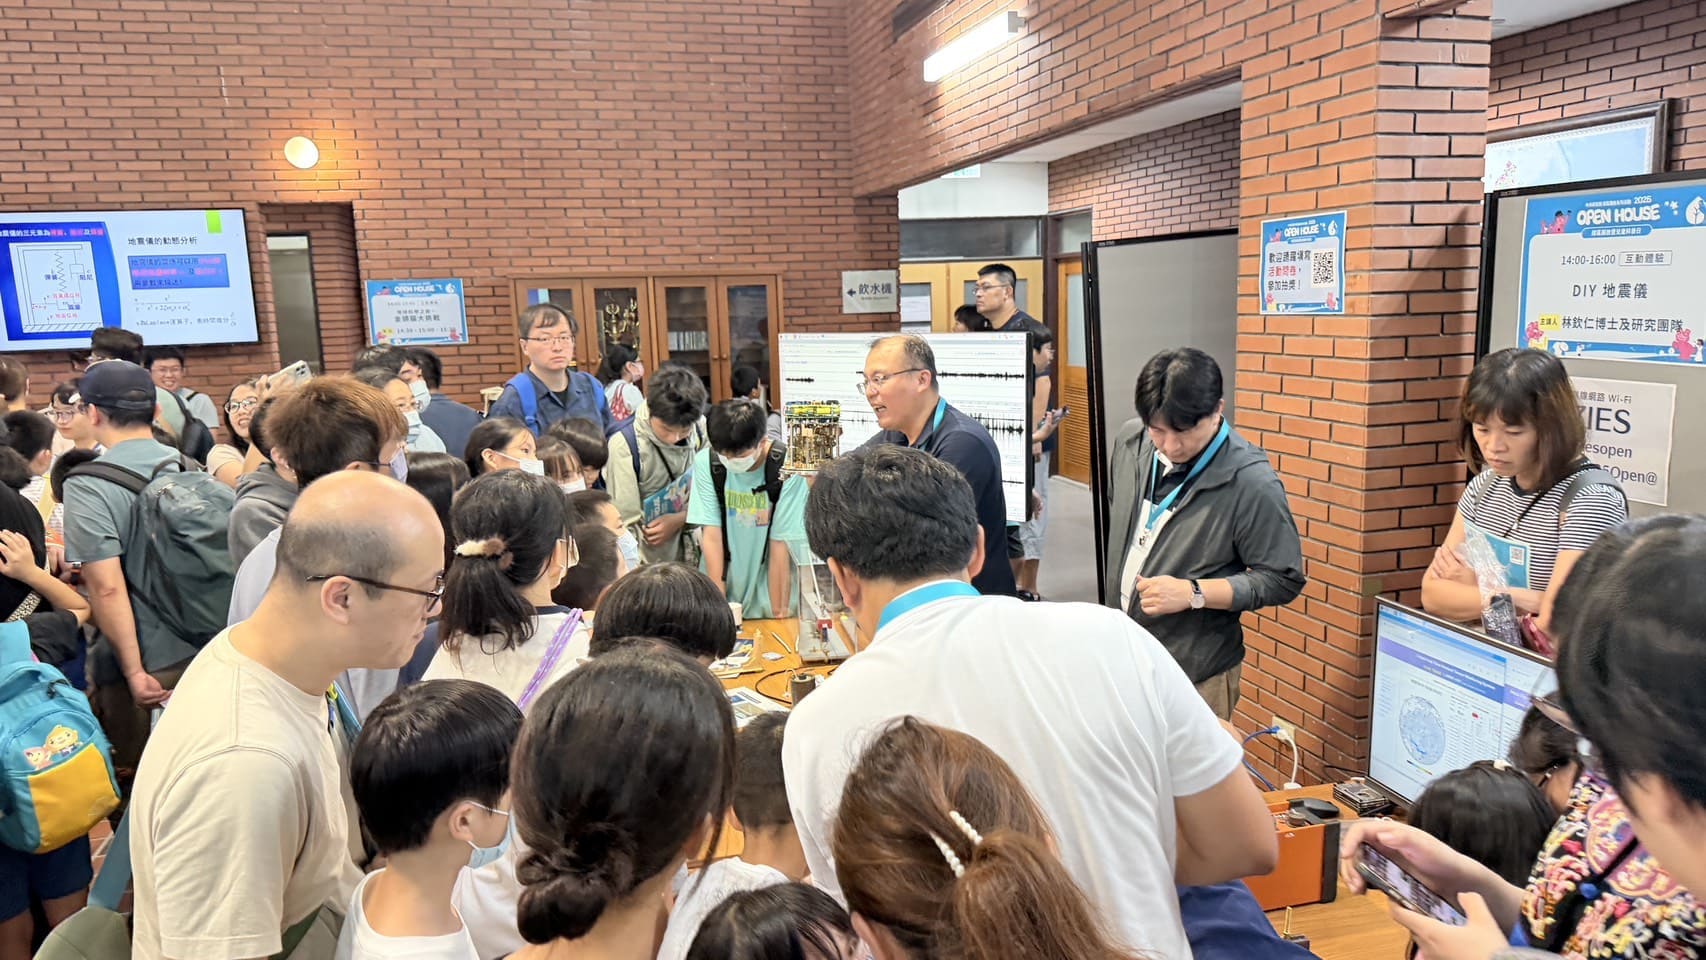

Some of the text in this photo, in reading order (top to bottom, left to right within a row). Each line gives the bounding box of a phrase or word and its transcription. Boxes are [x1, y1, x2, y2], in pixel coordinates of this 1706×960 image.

[1634, 195, 1652, 205] 2025
[1576, 208, 1612, 226] OPEN
[1614, 203, 1661, 223] HOUSE
[1284, 227, 1300, 237] OPEN
[1300, 224, 1320, 235] HOUSE
[127, 237, 197, 246] 地震儀的動態分析
[1561, 252, 1665, 266] 14:00-16:00 互動體驗
[858, 283, 892, 295] 飲水機
[1572, 283, 1648, 299] DIY 地震儀
[1540, 315, 1684, 332] 主講人 林欽仁博士及研究團隊
[1576, 391, 1632, 404] 線網路 Wi-Fi
